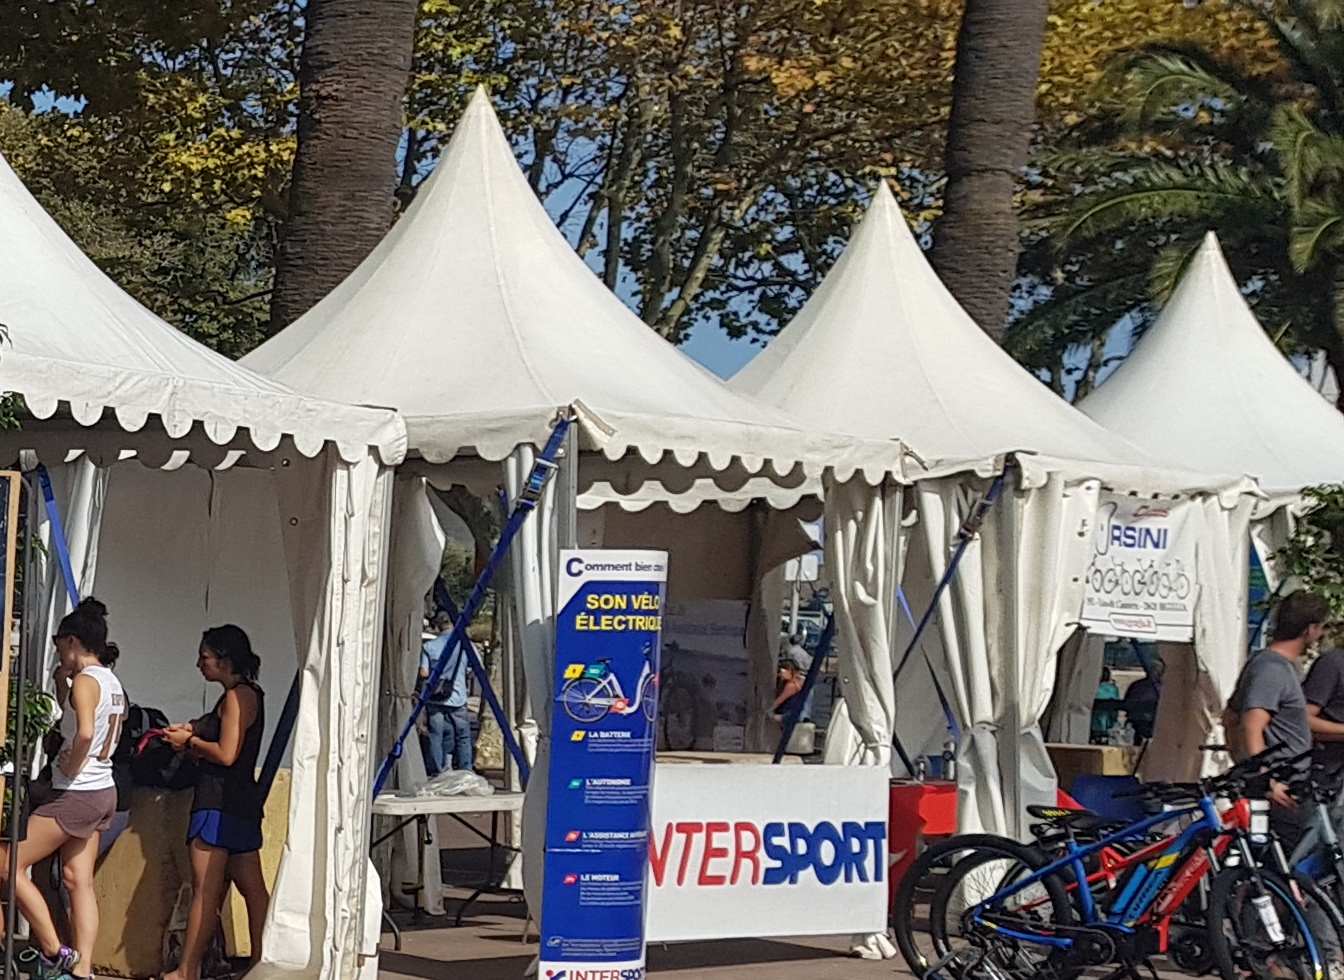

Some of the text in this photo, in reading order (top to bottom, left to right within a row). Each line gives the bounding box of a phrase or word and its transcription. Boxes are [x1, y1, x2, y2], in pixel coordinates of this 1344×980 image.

[566, 557, 632, 577] Comment
[586, 594, 627, 610] SON
[648, 822, 886, 886] NTERSPORT
